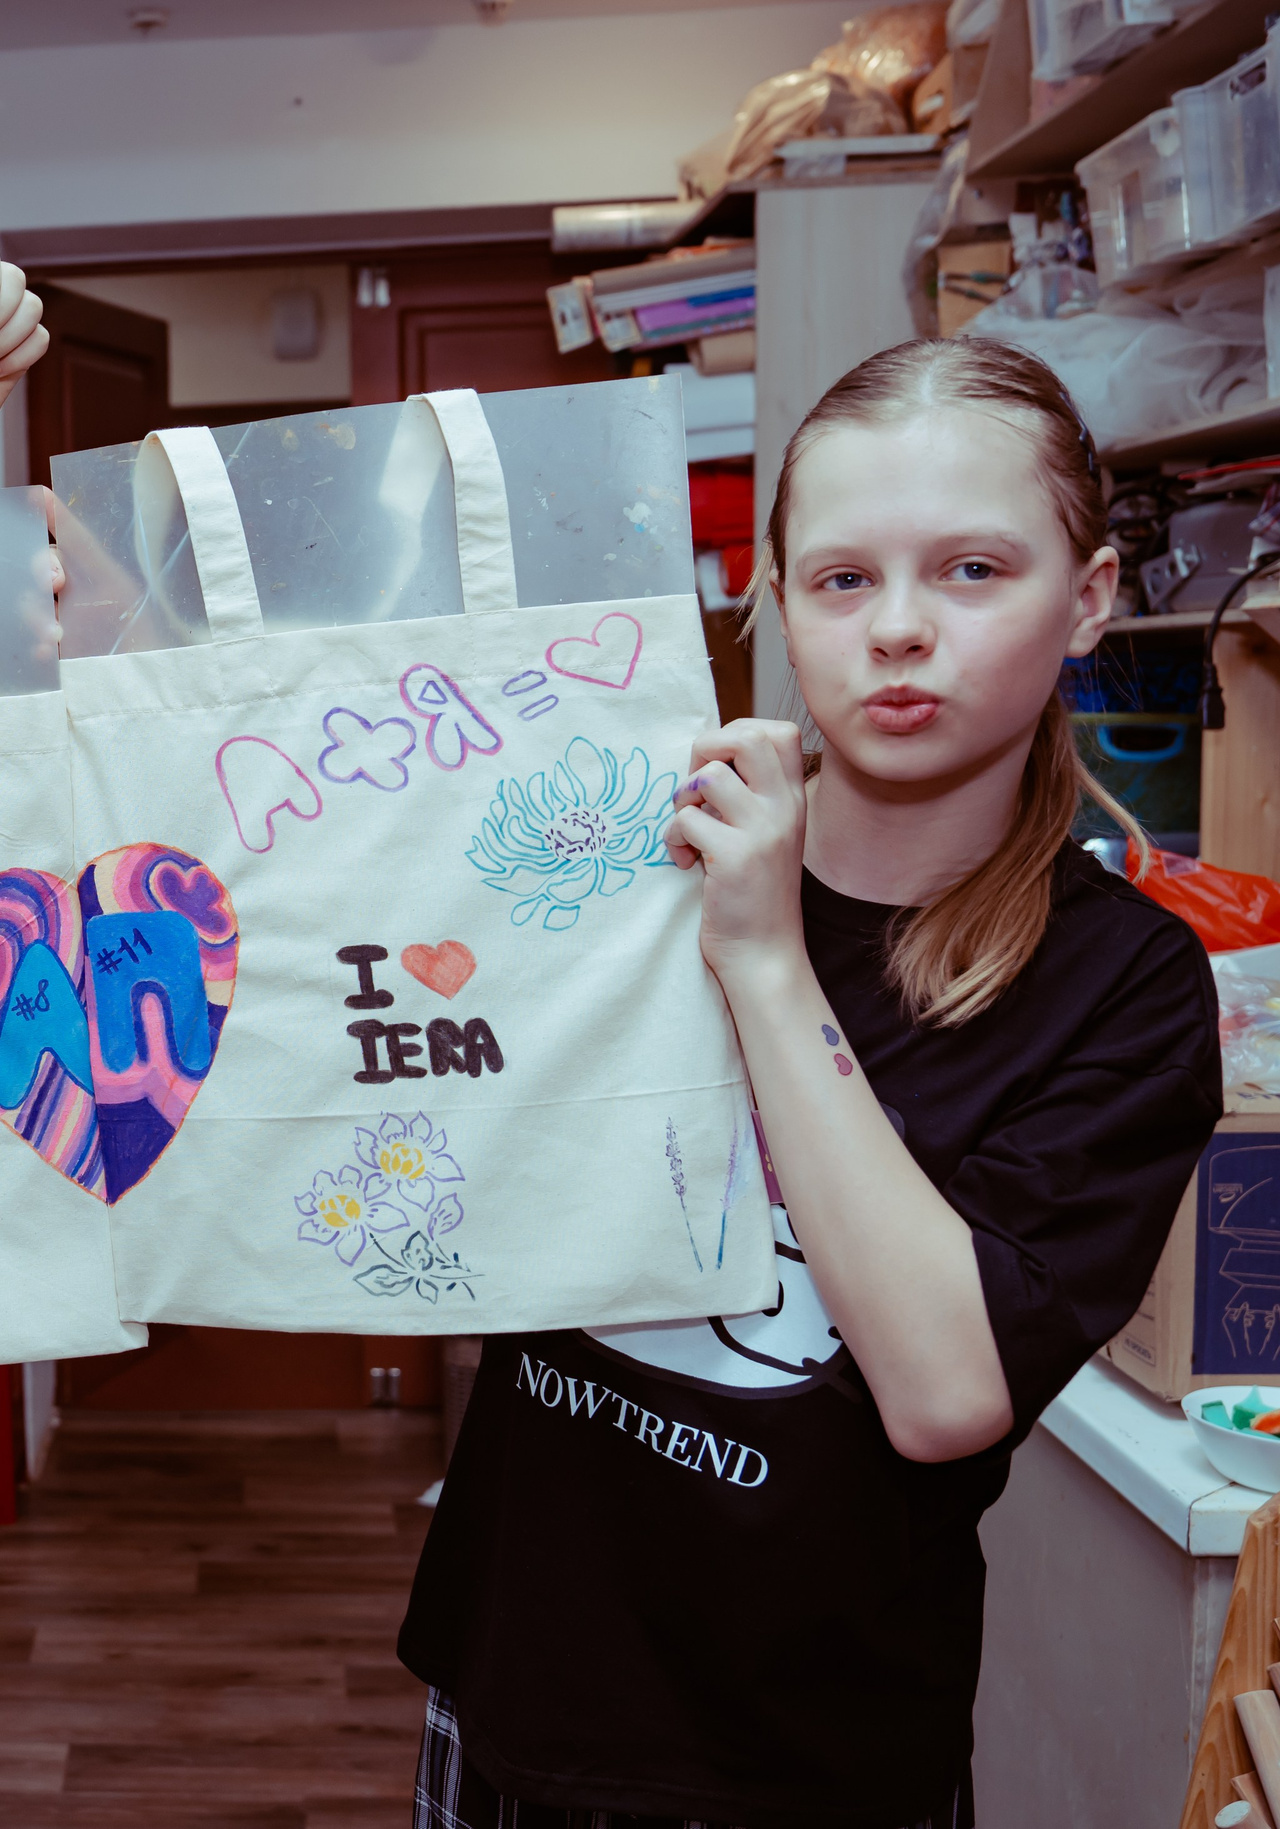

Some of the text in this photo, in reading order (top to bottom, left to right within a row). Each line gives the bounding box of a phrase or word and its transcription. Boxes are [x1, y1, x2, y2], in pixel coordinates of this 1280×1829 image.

[95, 928, 153, 976] #11
[336, 944, 395, 1010] I
[11, 979, 50, 1021] #8
[516, 1352, 769, 1488] NOWTREND
